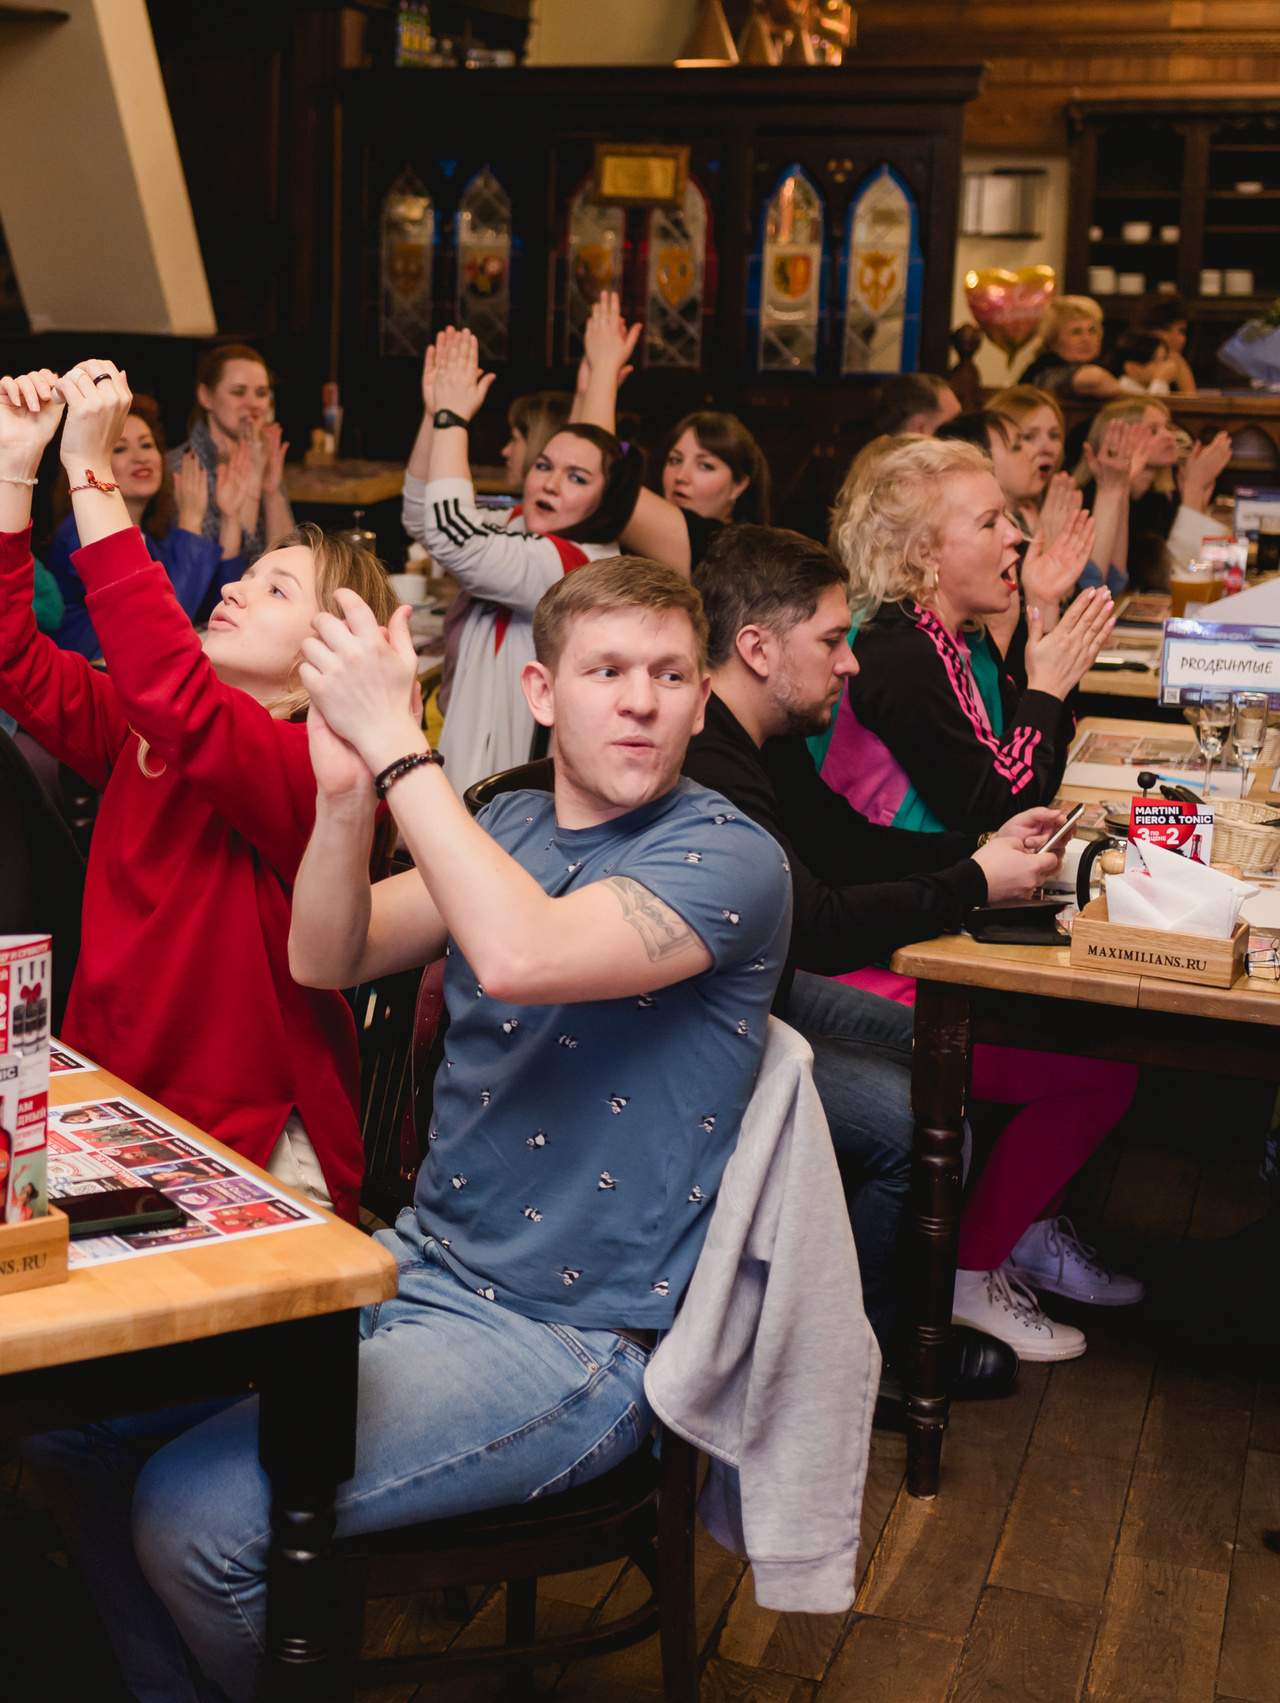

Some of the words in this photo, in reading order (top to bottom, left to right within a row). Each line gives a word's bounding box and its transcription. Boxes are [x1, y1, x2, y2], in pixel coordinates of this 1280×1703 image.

[1135, 806, 1179, 815] MARTINI
[1135, 816, 1166, 824] FIERO
[1168, 816, 1176, 824] &
[1178, 815, 1211, 824] TONIC
[1137, 828, 1150, 843] 3
[1166, 828, 1179, 845] 2
[1088, 945, 1207, 971] MAXIMILIANS.RU
